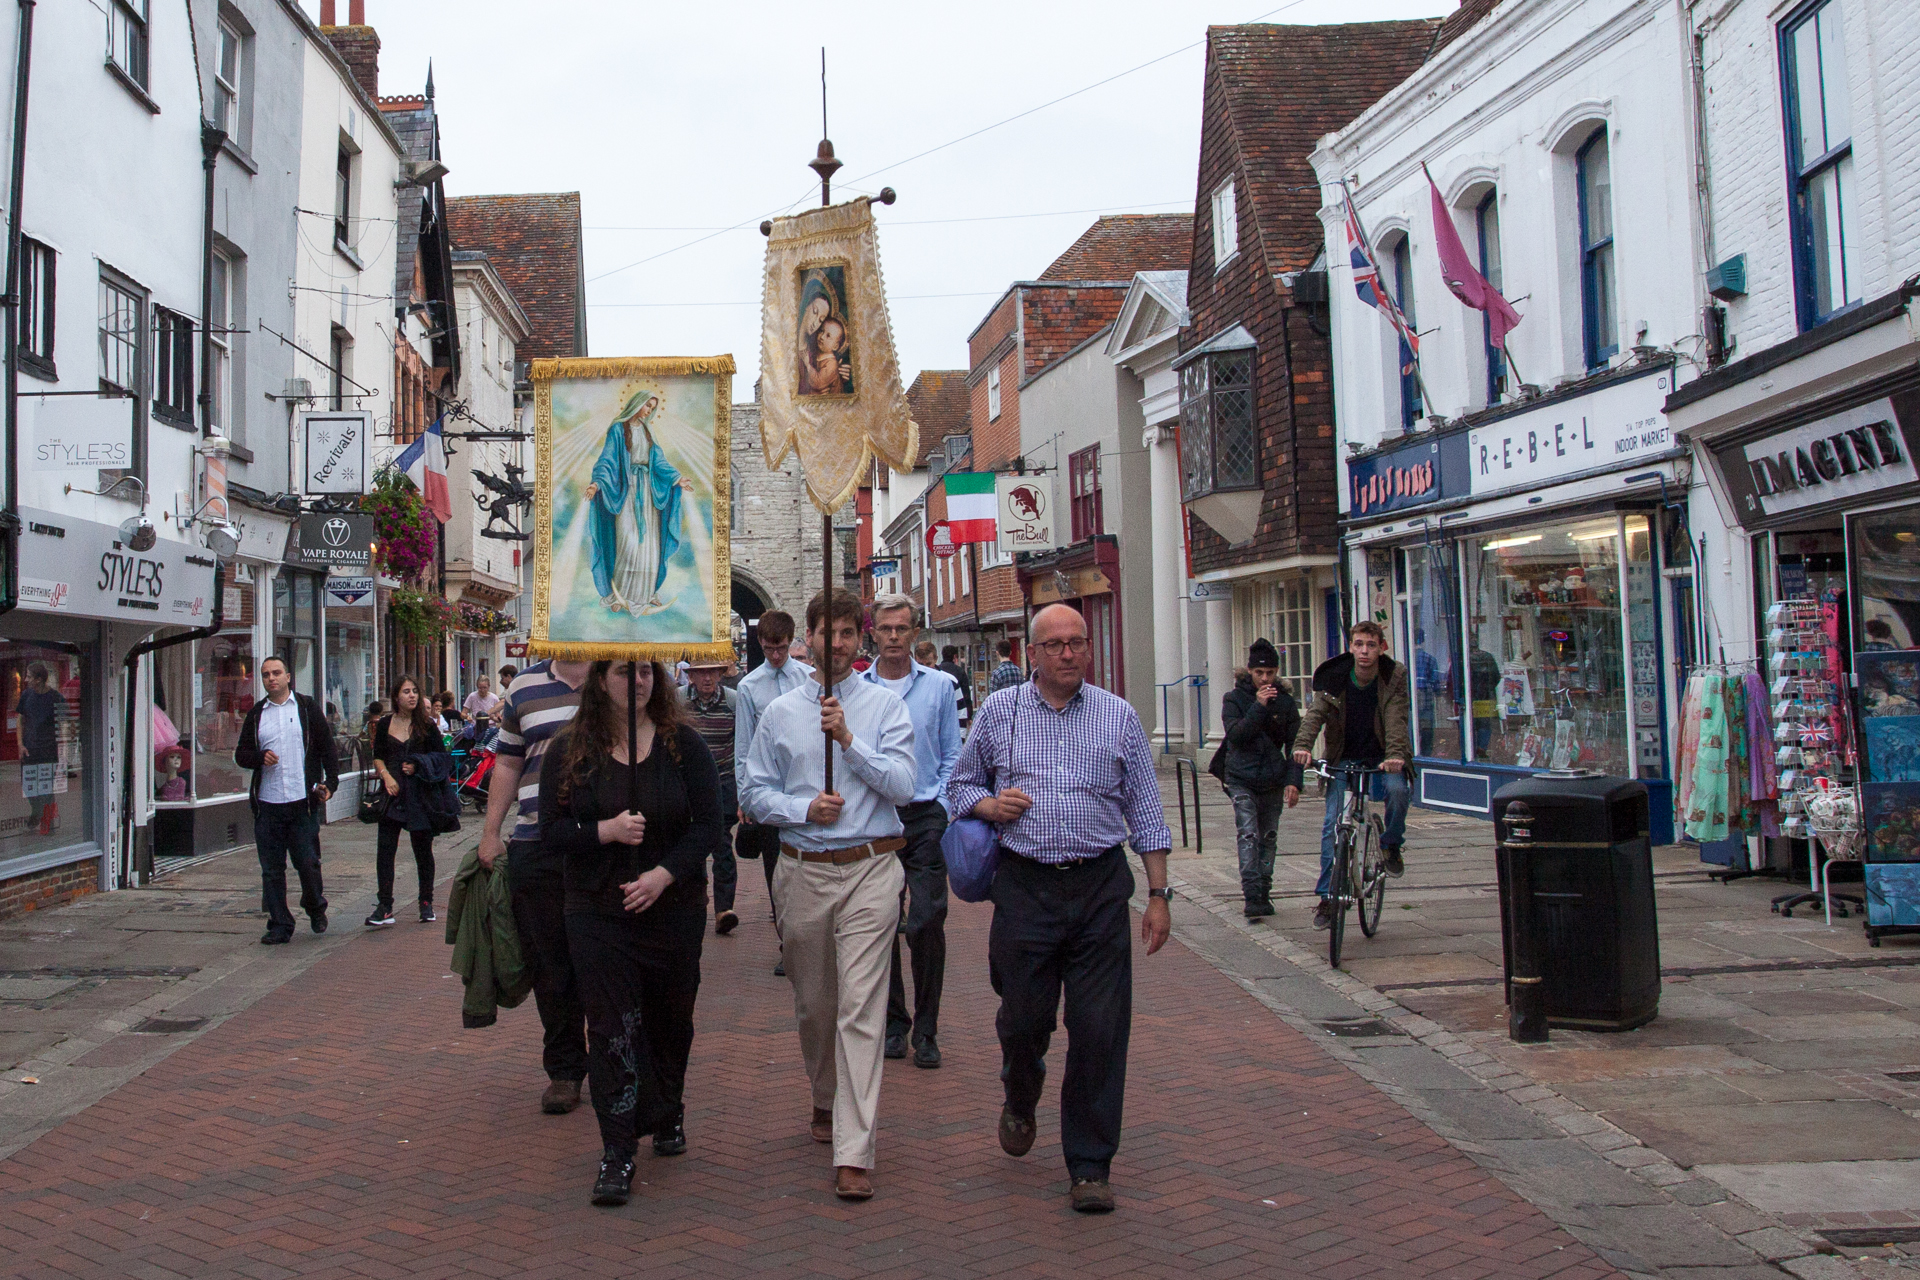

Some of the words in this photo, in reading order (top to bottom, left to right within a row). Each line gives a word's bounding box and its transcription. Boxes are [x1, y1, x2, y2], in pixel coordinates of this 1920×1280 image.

[1615, 435, 1638, 454] INDOOR
[1641, 427, 1669, 448] MARKET
[37, 443, 126, 461] STYLERS
[313, 426, 356, 484] Revivals
[1749, 420, 1902, 497] IMAGINE
[1005, 529, 1026, 544] The
[1025, 523, 1050, 544] Bull
[302, 548, 327, 558] VAPE
[330, 549, 369, 560] ROYALE
[97, 552, 164, 598] STYLERS
[21, 586, 51, 598] EVERYTHING
[327, 581, 350, 590] MAISON
[355, 580, 373, 590] CAFÉ
[110, 801, 116, 814] A
